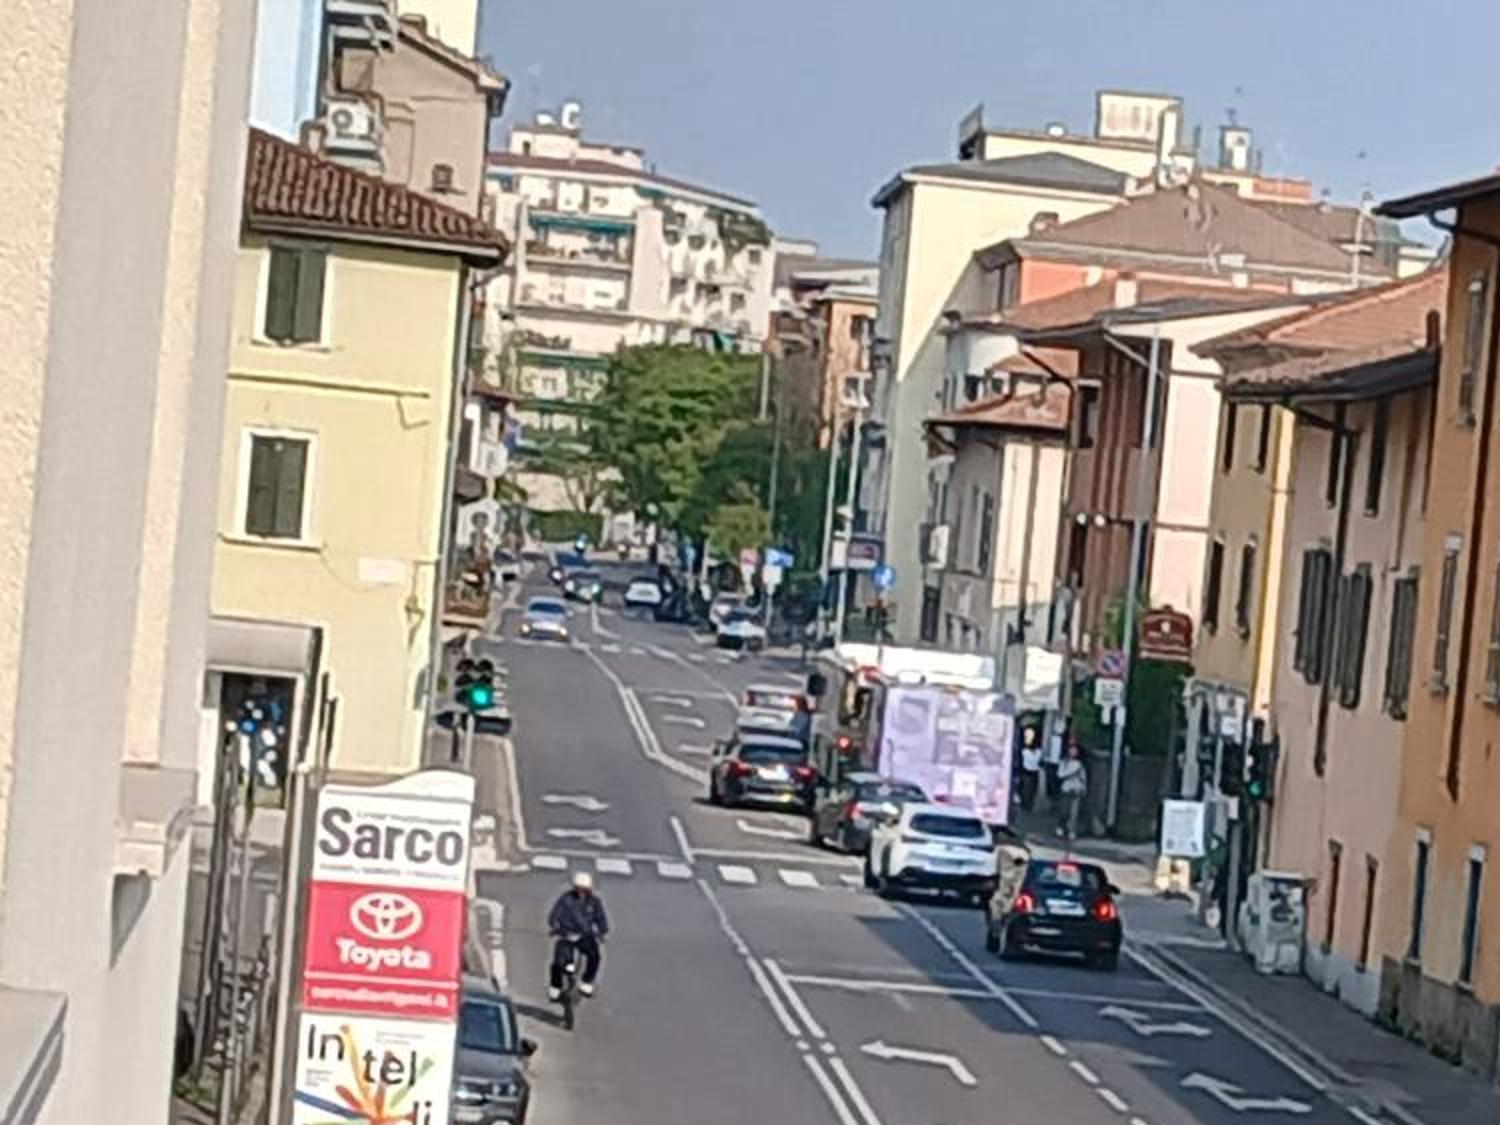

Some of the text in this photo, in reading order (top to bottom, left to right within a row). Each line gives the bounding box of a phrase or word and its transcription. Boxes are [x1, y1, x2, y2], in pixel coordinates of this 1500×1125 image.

[319, 806, 464, 866] Sarco
[335, 936, 432, 972] Toyota
[307, 1023, 345, 1061] In
[363, 1049, 417, 1087] tel
